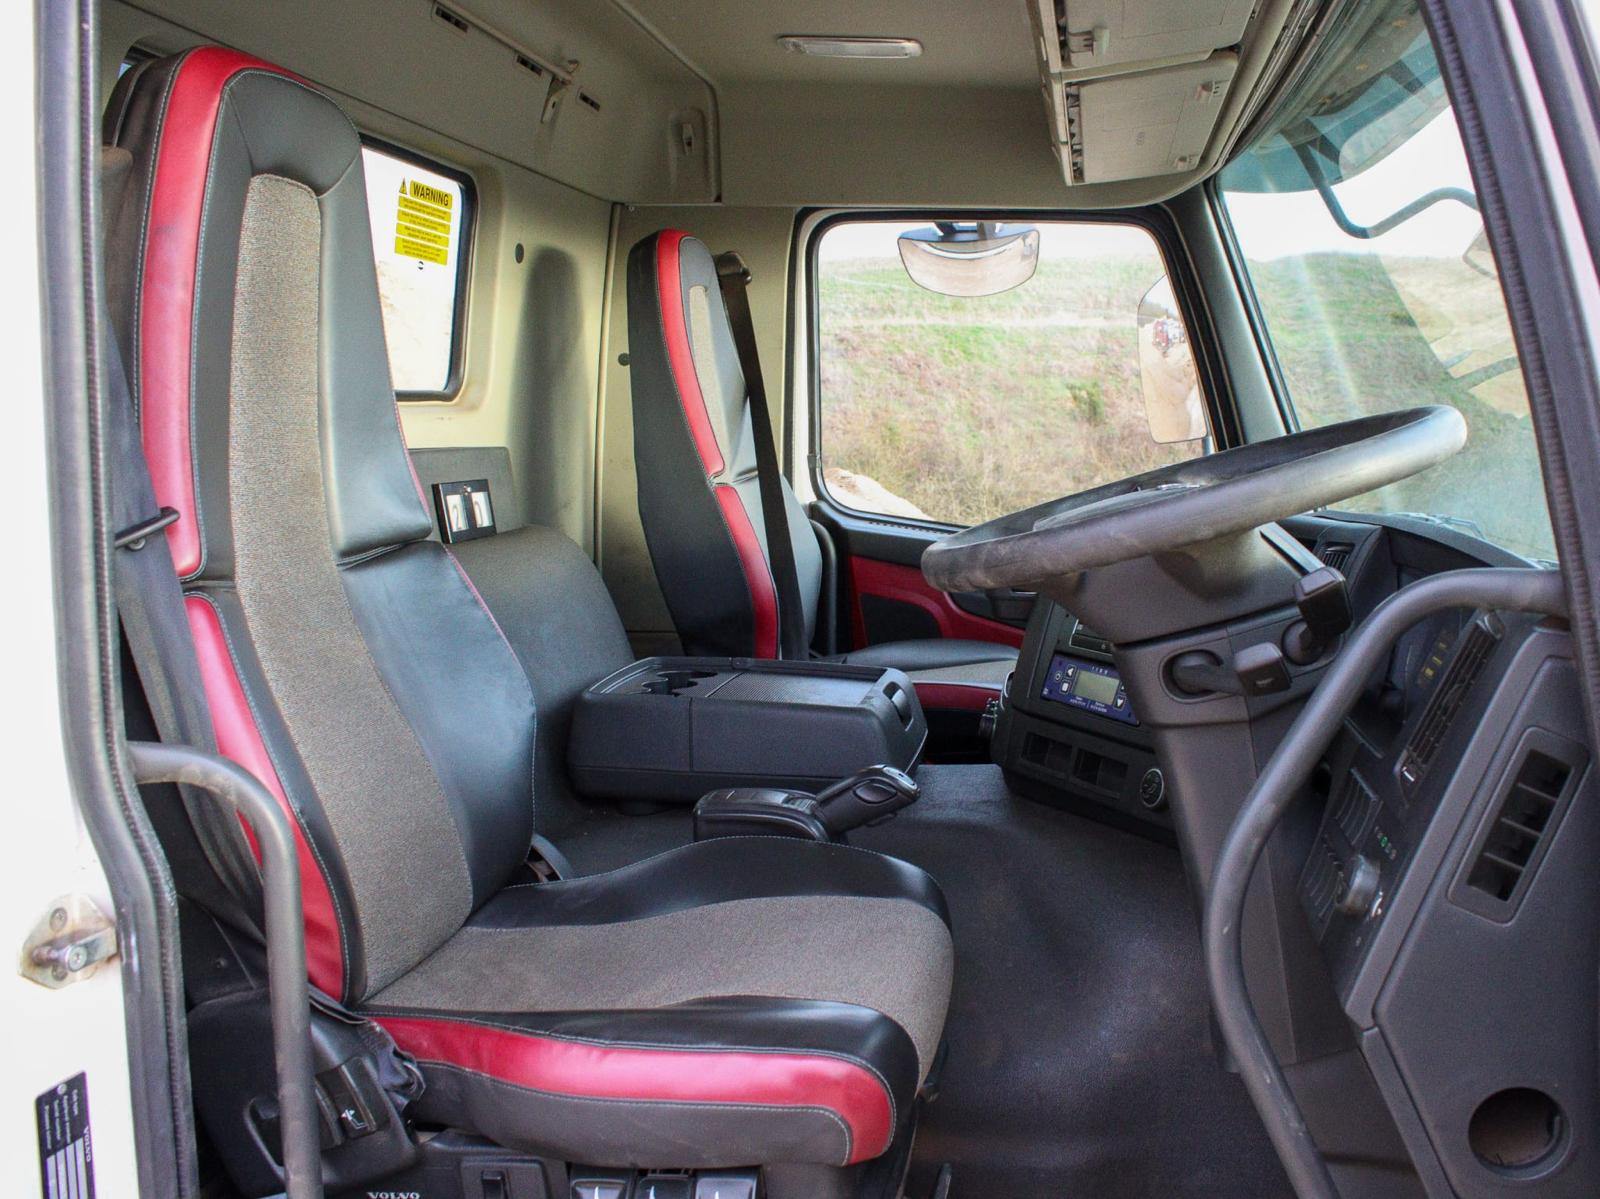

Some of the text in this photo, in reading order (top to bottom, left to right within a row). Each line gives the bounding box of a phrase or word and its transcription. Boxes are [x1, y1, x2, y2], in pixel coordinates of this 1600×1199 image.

[413, 181, 449, 207] WARNING
[83, 1126, 91, 1163] VOLVO
[366, 1191, 420, 1199] VOLVO
